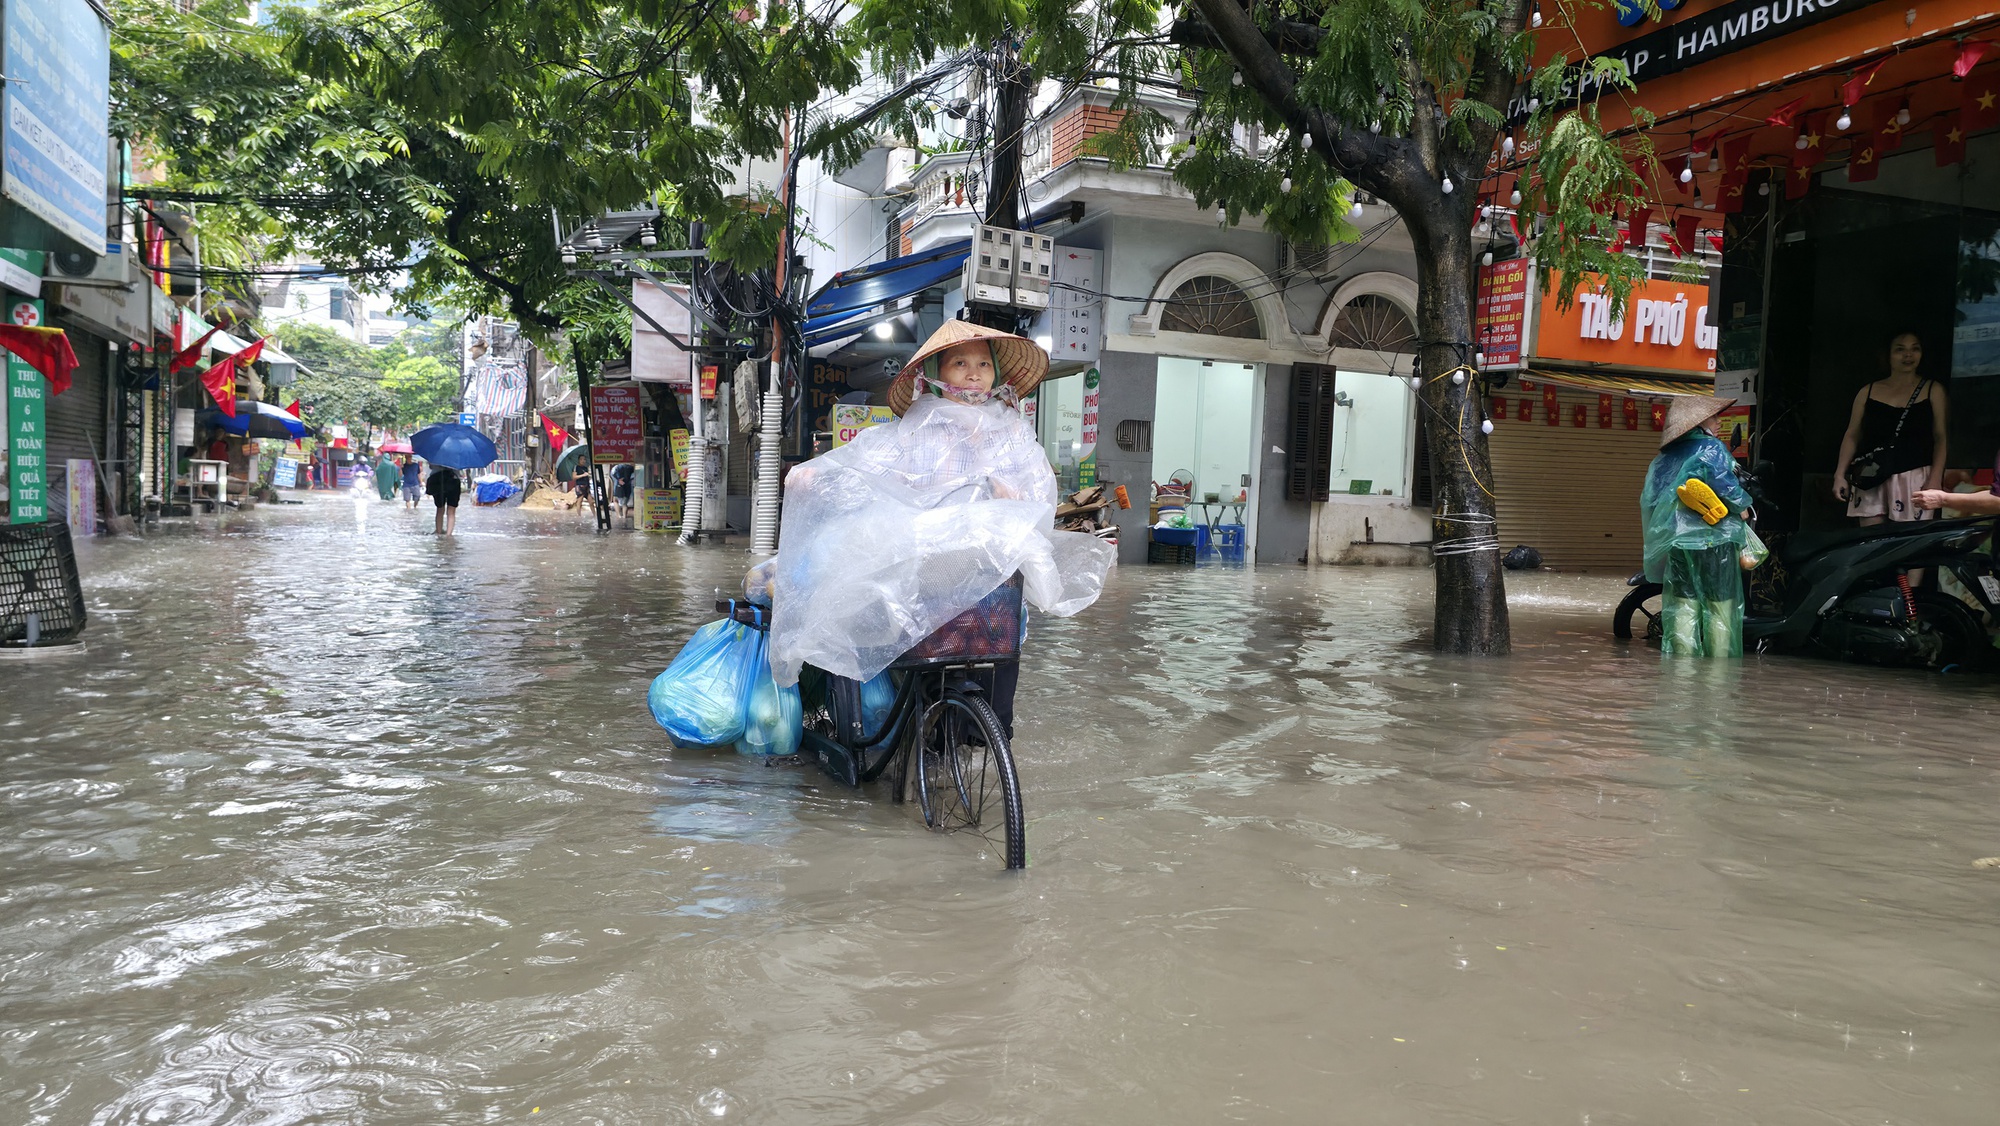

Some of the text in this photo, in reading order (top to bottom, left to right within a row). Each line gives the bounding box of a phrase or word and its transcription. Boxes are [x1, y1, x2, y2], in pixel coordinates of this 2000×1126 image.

[1507, 77, 1572, 119] TAS
[1508, 268, 1524, 282] GỐI
[1634, 293, 1688, 346] PHỚ
[17, 370, 36, 382] THU
[814, 363, 851, 384] Bán
[14, 384, 41, 398] HÀNG
[810, 388, 843, 408] Trá
[24, 404, 30, 415] 6
[1084, 410, 1098, 426] BÚN
[21, 422, 34, 432] AN
[840, 427, 866, 442] CH
[16, 436, 42, 449] TOÀN
[17, 453, 40, 468] HIỆU
[20, 469, 40, 486] QUẢ
[19, 486, 40, 500] TIẾT
[18, 504, 42, 519] KIỆM
